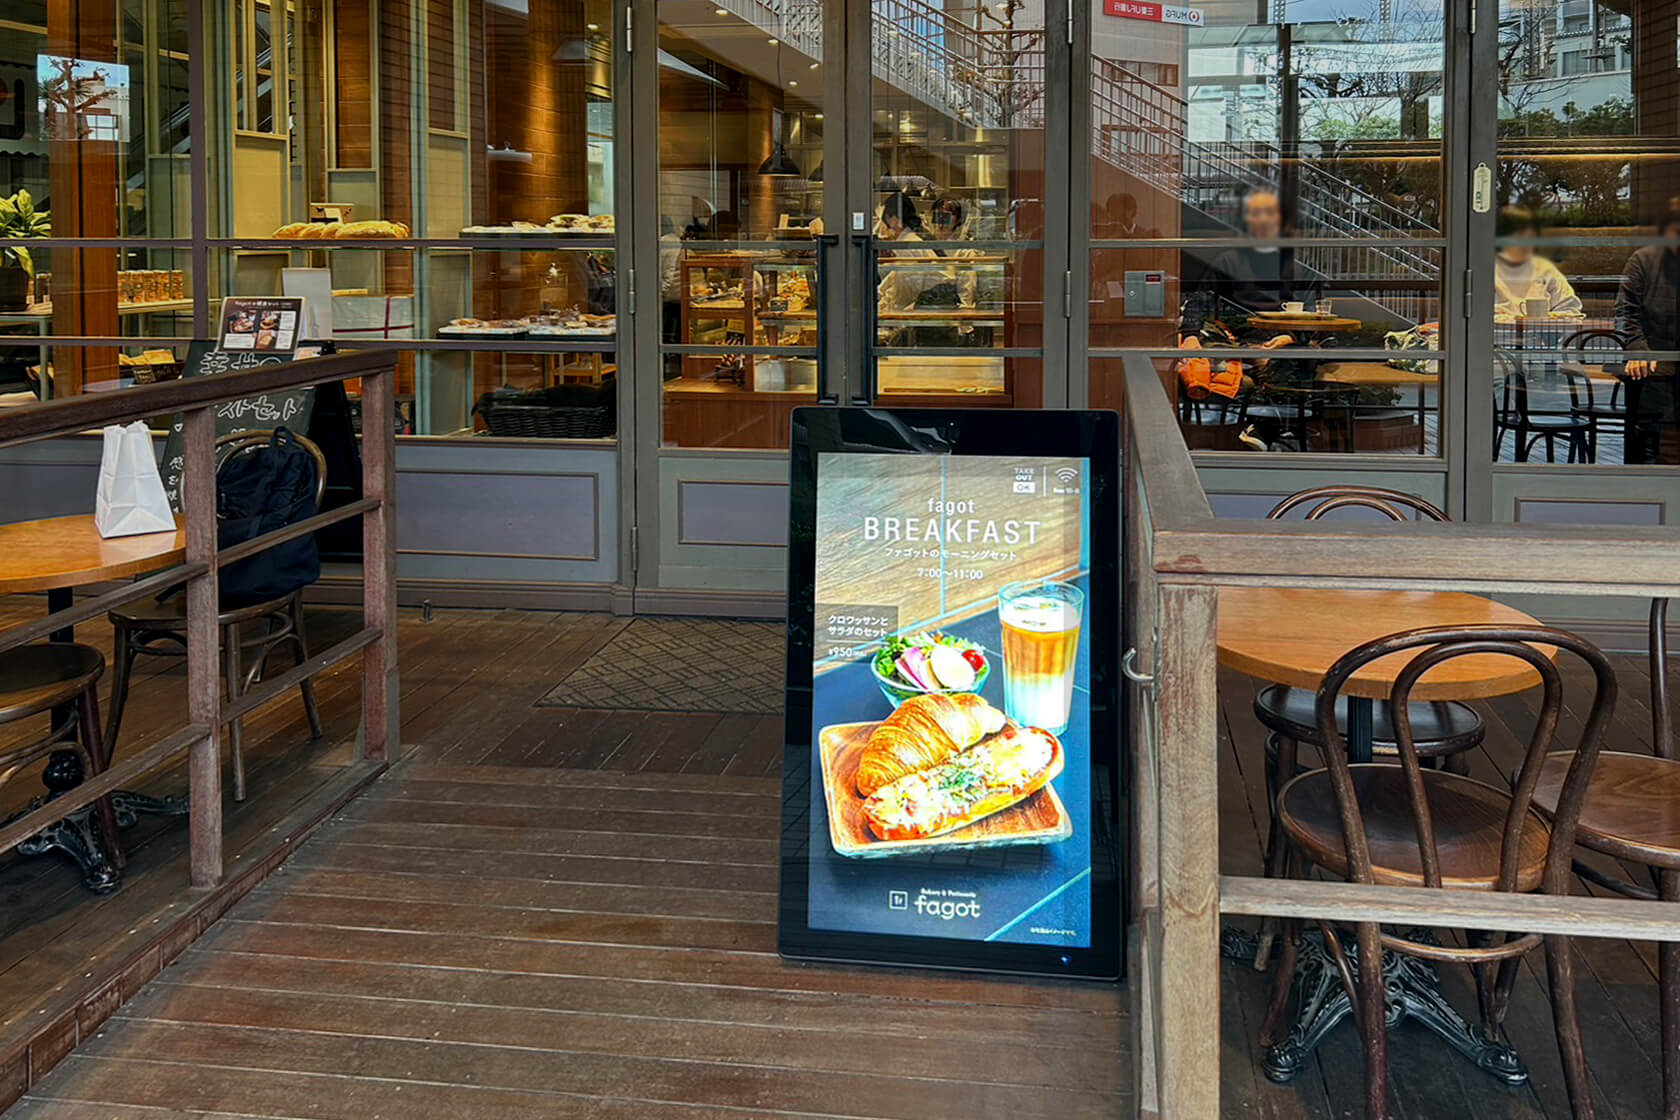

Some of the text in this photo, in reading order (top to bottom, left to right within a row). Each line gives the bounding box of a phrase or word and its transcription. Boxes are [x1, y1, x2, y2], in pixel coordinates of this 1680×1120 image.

[1016, 483, 1032, 491] OK
[927, 498, 976, 516] fagot
[864, 517, 1041, 545] BREAKFAST
[885, 547, 1017, 561] ファゴットのモーニングセット
[828, 615, 889, 626] クロワッサンと
[828, 626, 888, 637] サラダのセット
[914, 895, 981, 920] fagot
